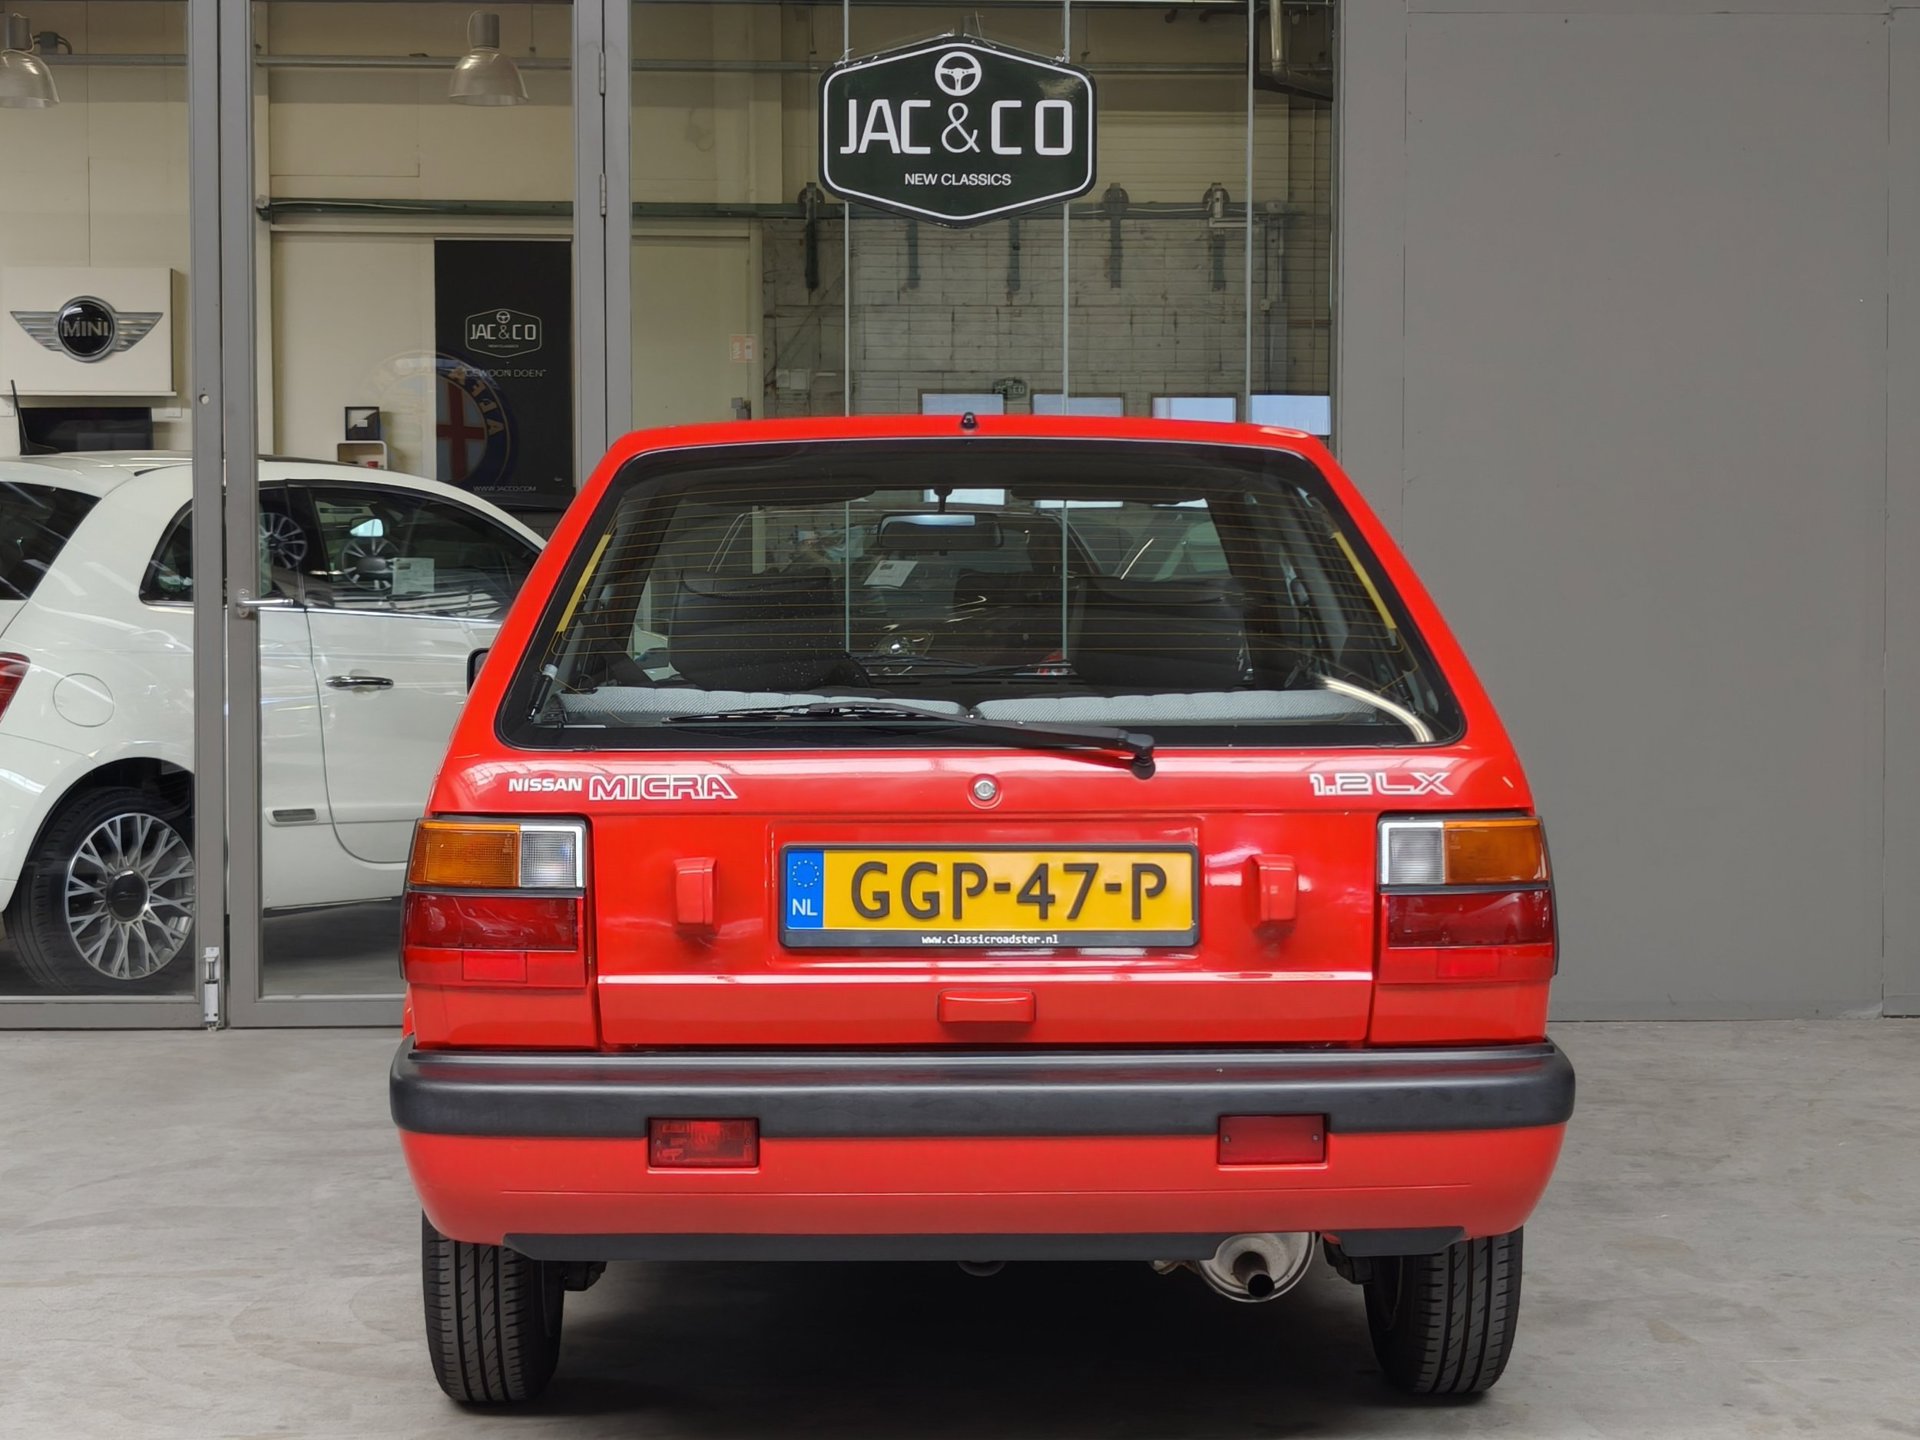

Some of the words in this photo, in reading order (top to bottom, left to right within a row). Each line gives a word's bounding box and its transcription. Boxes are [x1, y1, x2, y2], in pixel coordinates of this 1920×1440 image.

[904, 173, 938, 186] NEW
[940, 173, 1012, 187] CLASSICS
[63, 320, 109, 337] MINI
[508, 777, 583, 792] NISSAN
[589, 774, 738, 800] MICRA
[792, 898, 818, 916] NL
[850, 860, 1168, 921] GGP-47-P
[921, 934, 1059, 945] www.classicroadster.nl
